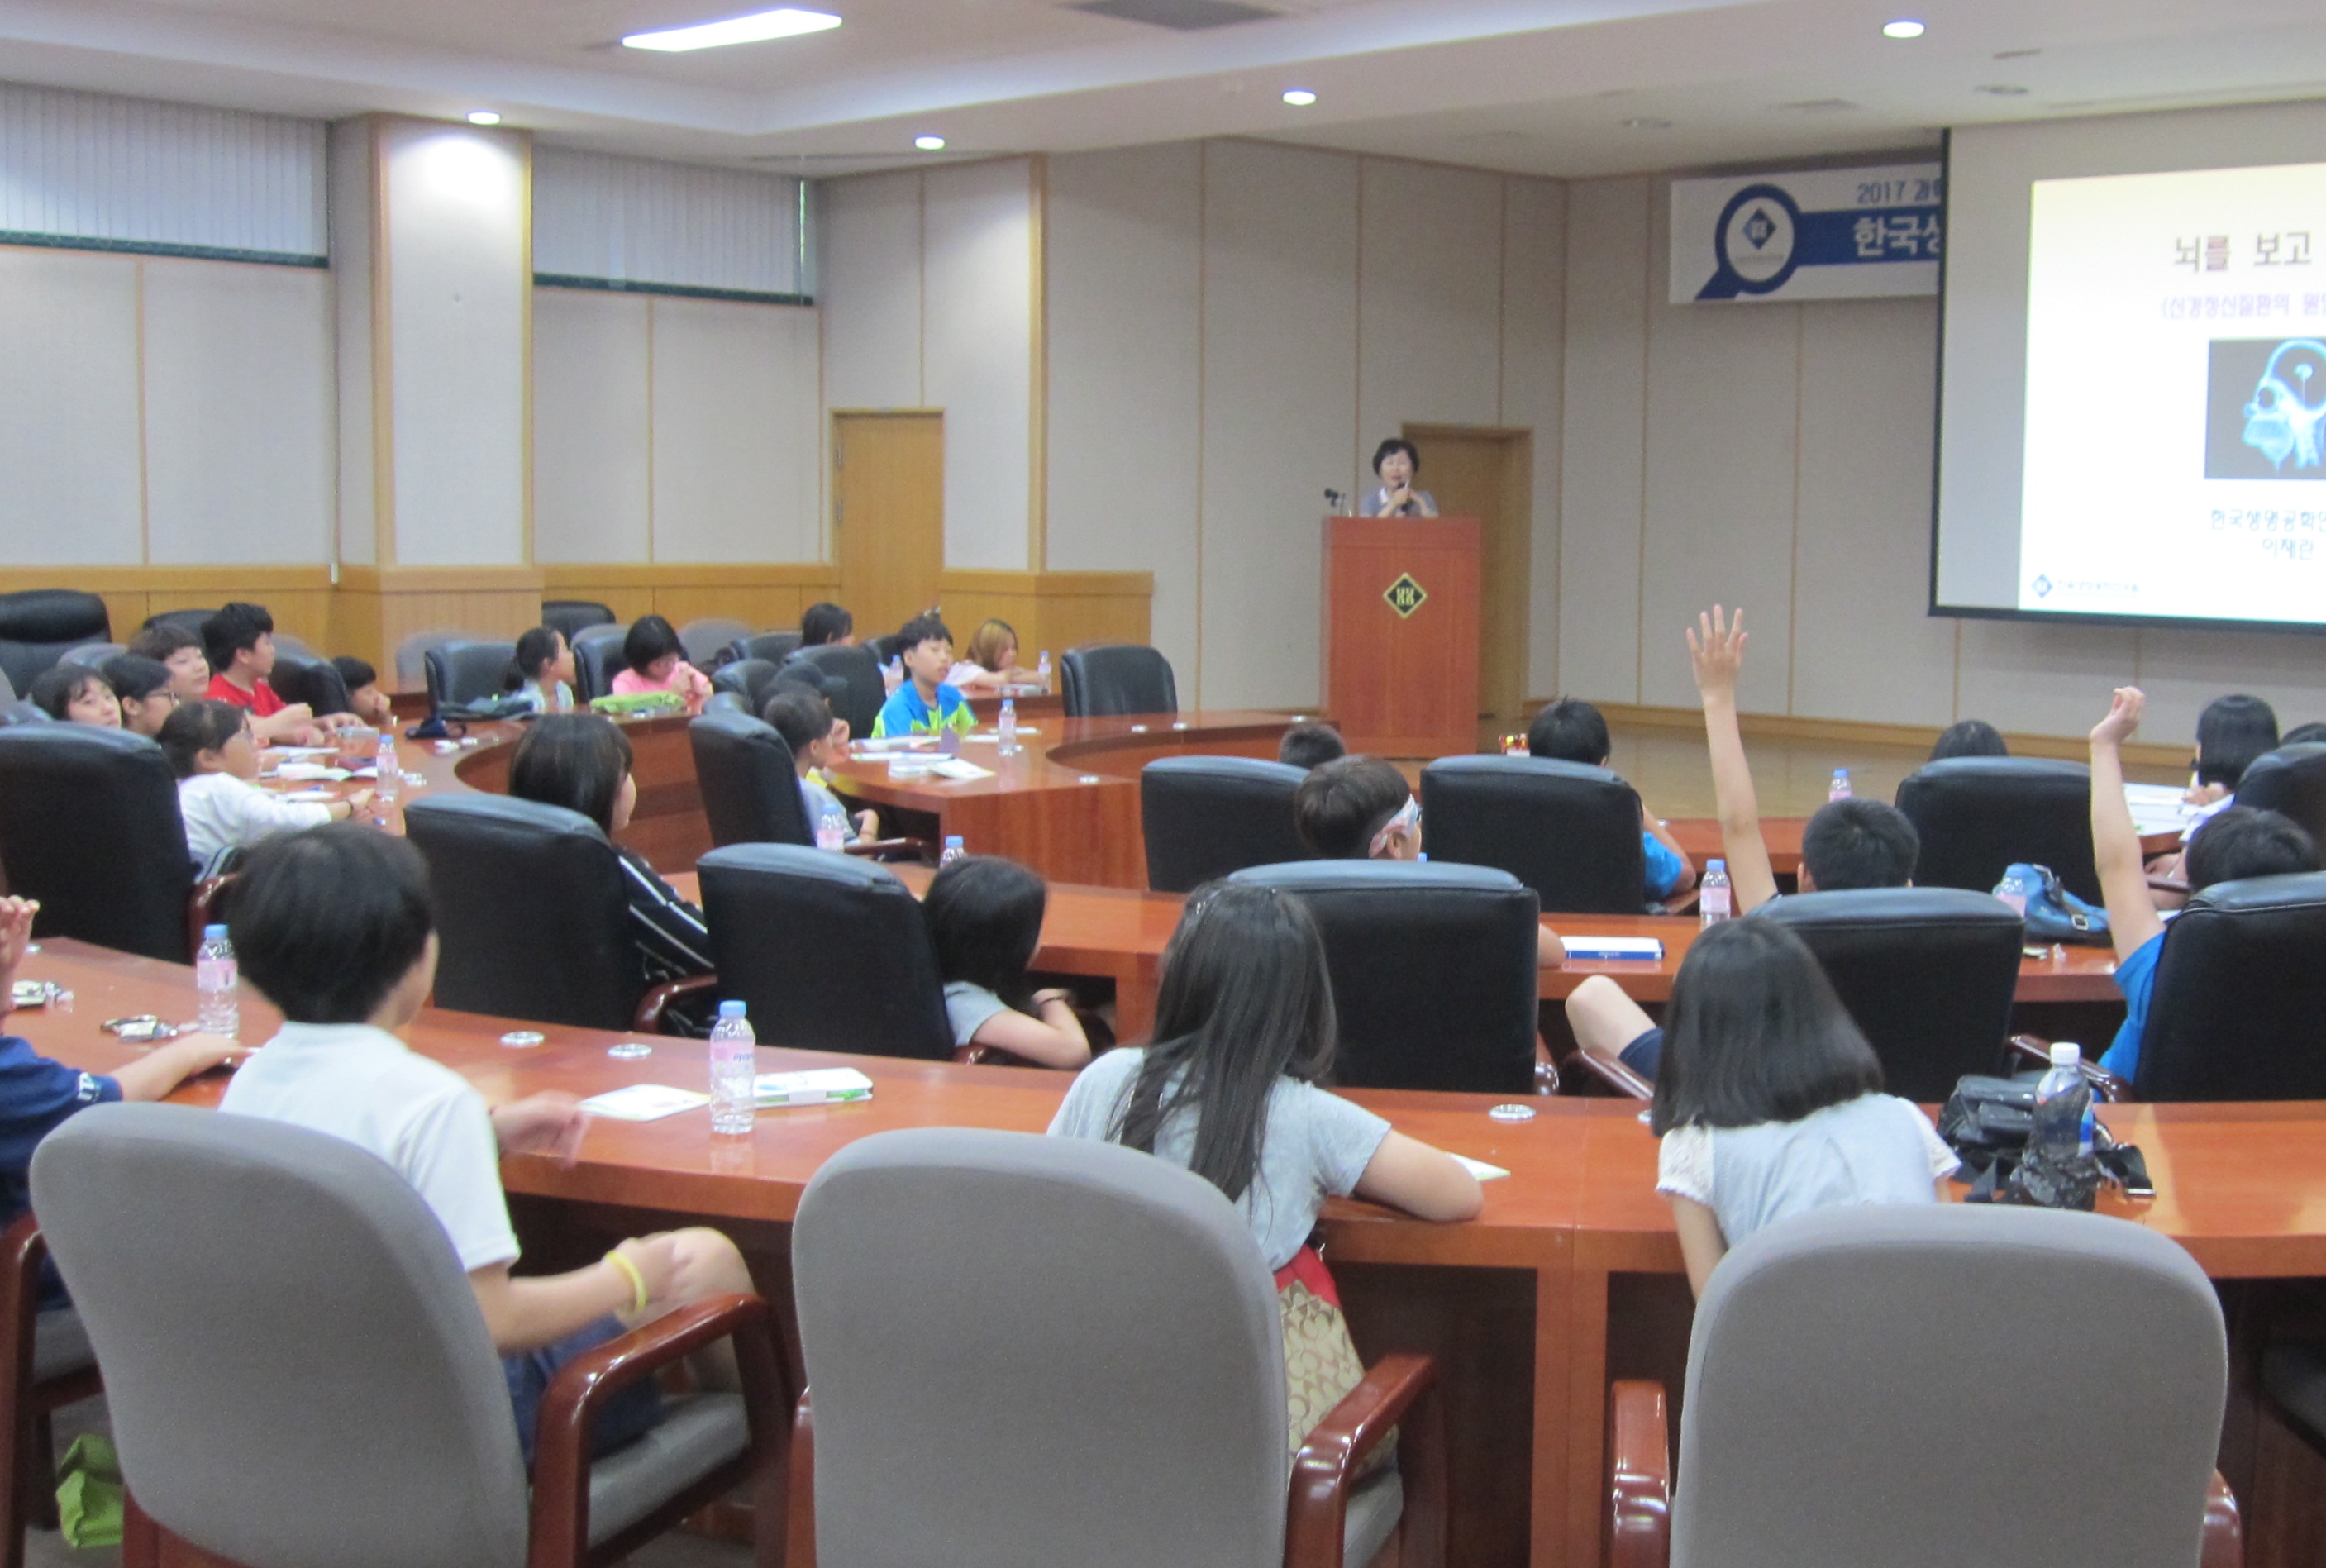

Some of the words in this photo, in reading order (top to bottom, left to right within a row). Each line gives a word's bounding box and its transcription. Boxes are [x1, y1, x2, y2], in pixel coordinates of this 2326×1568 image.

[1857, 180, 1906, 203] 2017
[2175, 236, 2229, 273] 뇌를
[2254, 232, 2311, 266] 보고
